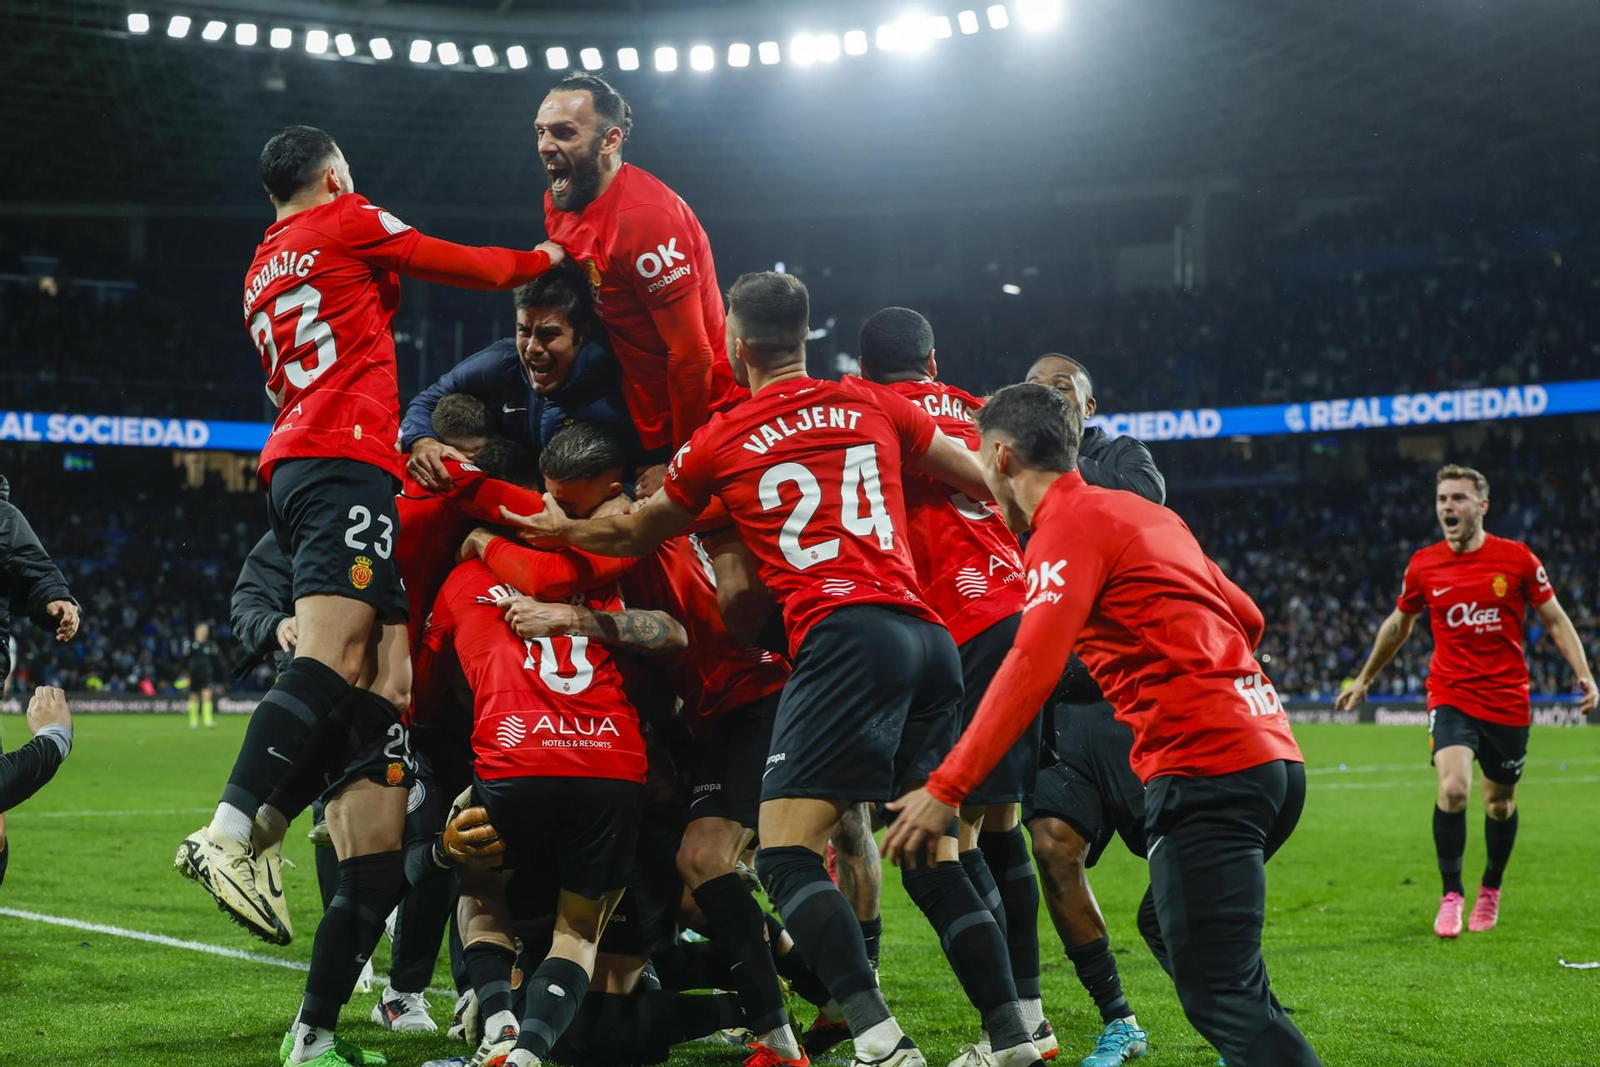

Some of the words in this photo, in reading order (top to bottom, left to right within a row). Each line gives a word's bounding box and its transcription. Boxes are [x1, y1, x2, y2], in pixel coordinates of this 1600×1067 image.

[636, 237, 686, 279] OK
[647, 264, 692, 293] mobility
[1310, 397, 1388, 432] REAL
[1391, 384, 1549, 426] SOCIEDAD
[46, 413, 210, 448] SOCIEDAD
[742, 406, 862, 455] VALJENT
[757, 443, 895, 571] 24
[344, 504, 394, 560] 23
[531, 715, 620, 737] ALUA
[541, 739, 571, 748] HOTELS
[572, 739, 579, 748] &
[579, 739, 612, 749] RESORTS
